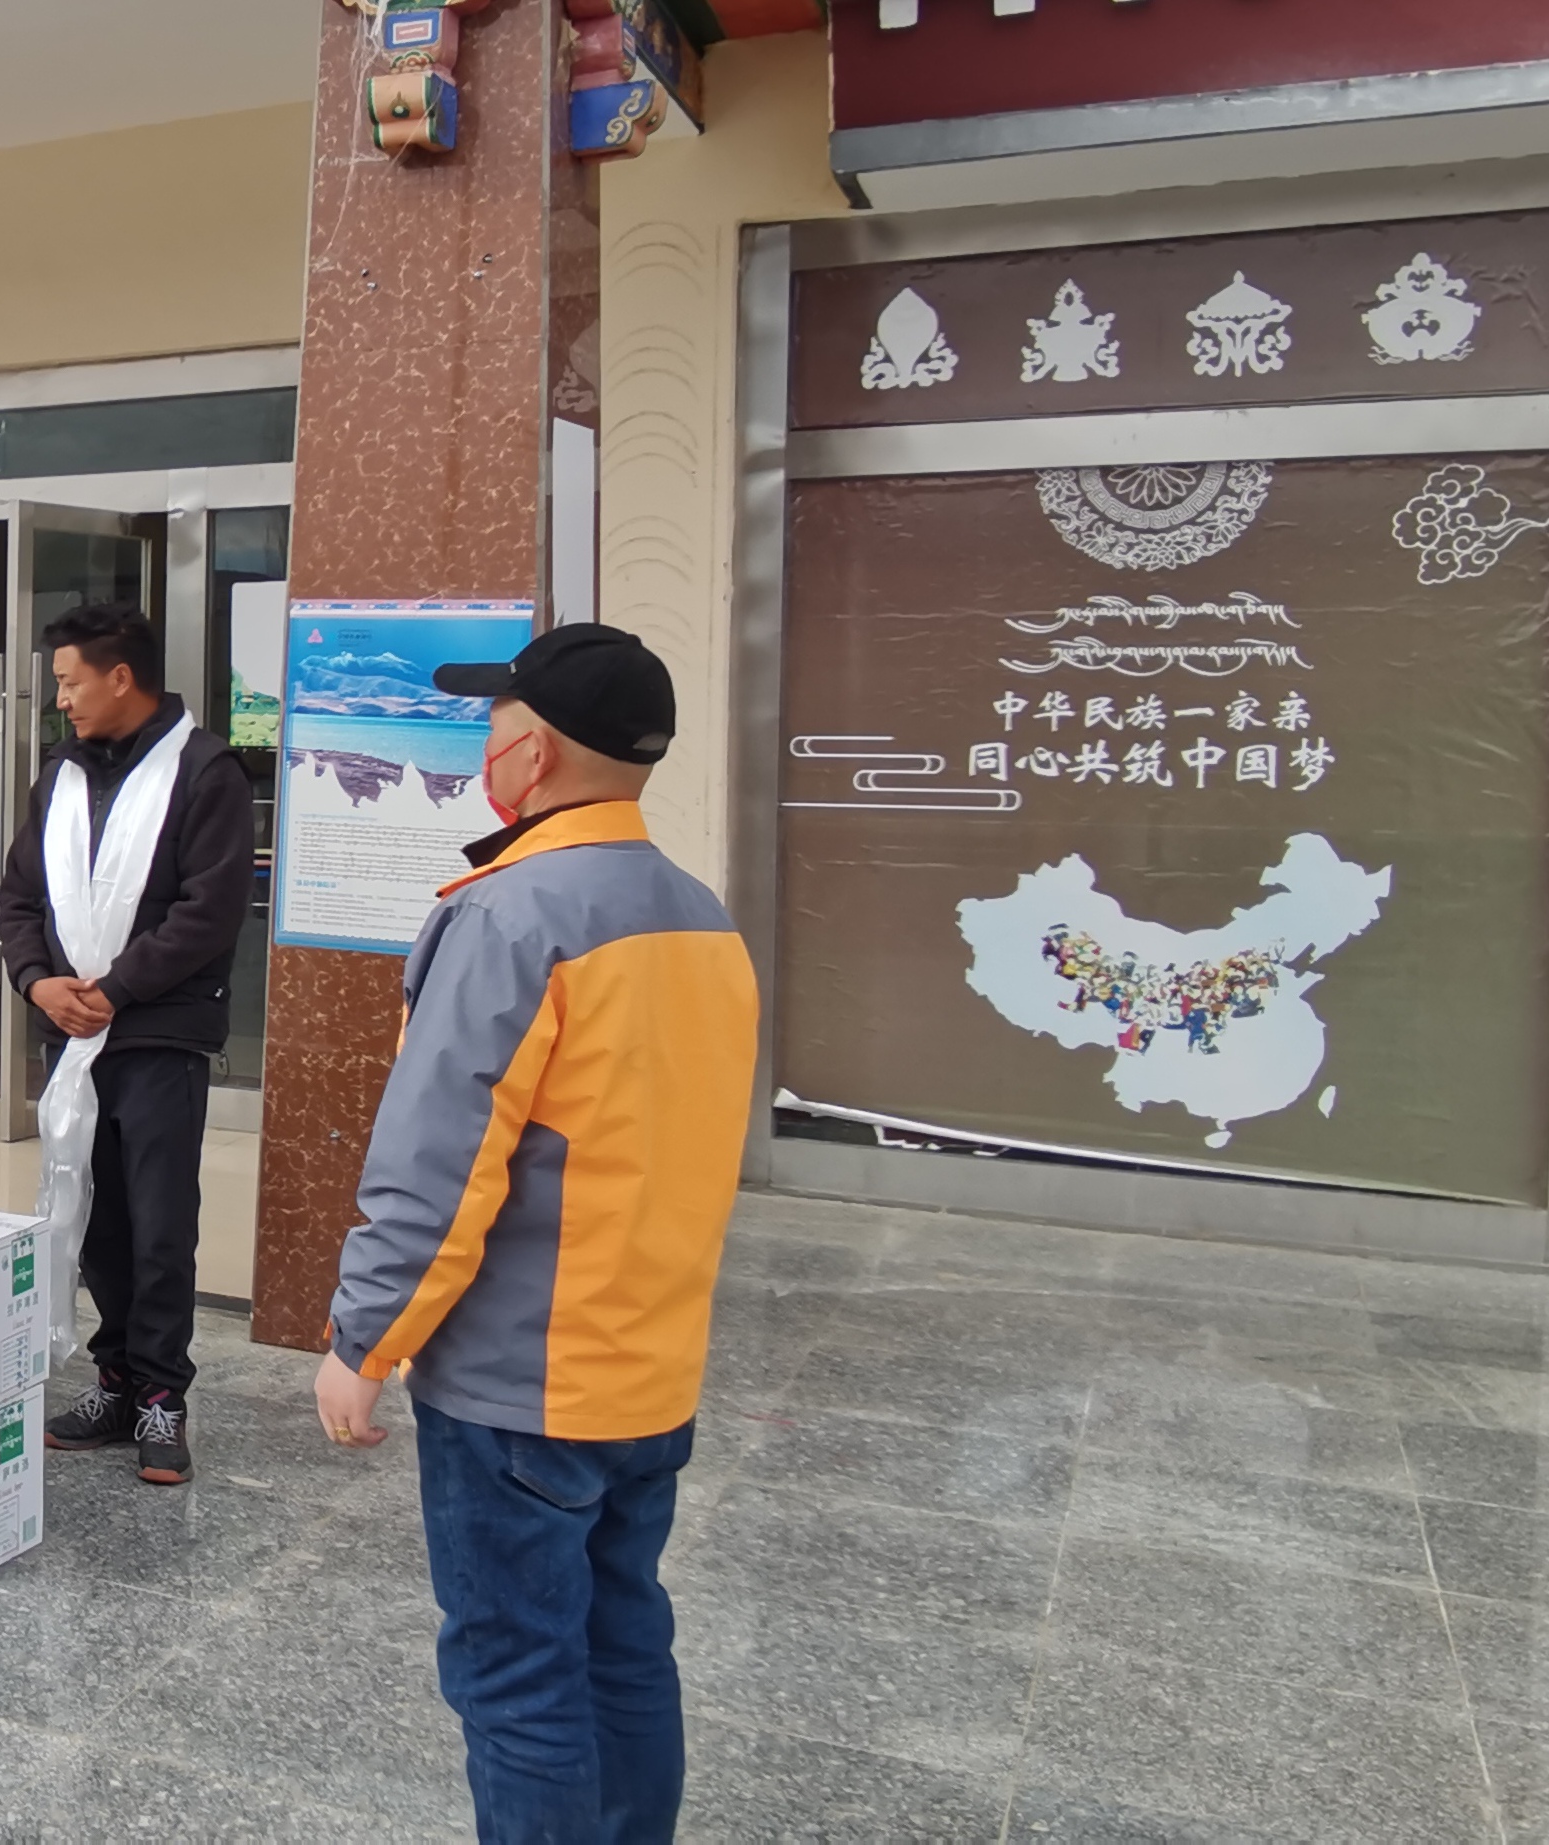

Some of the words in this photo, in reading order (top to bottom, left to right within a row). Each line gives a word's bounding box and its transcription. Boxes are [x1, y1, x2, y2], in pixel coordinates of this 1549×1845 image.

[993, 690, 1311, 732] 中华民族一家亲
[968, 736, 1336, 791] 同心共筑中国梦
